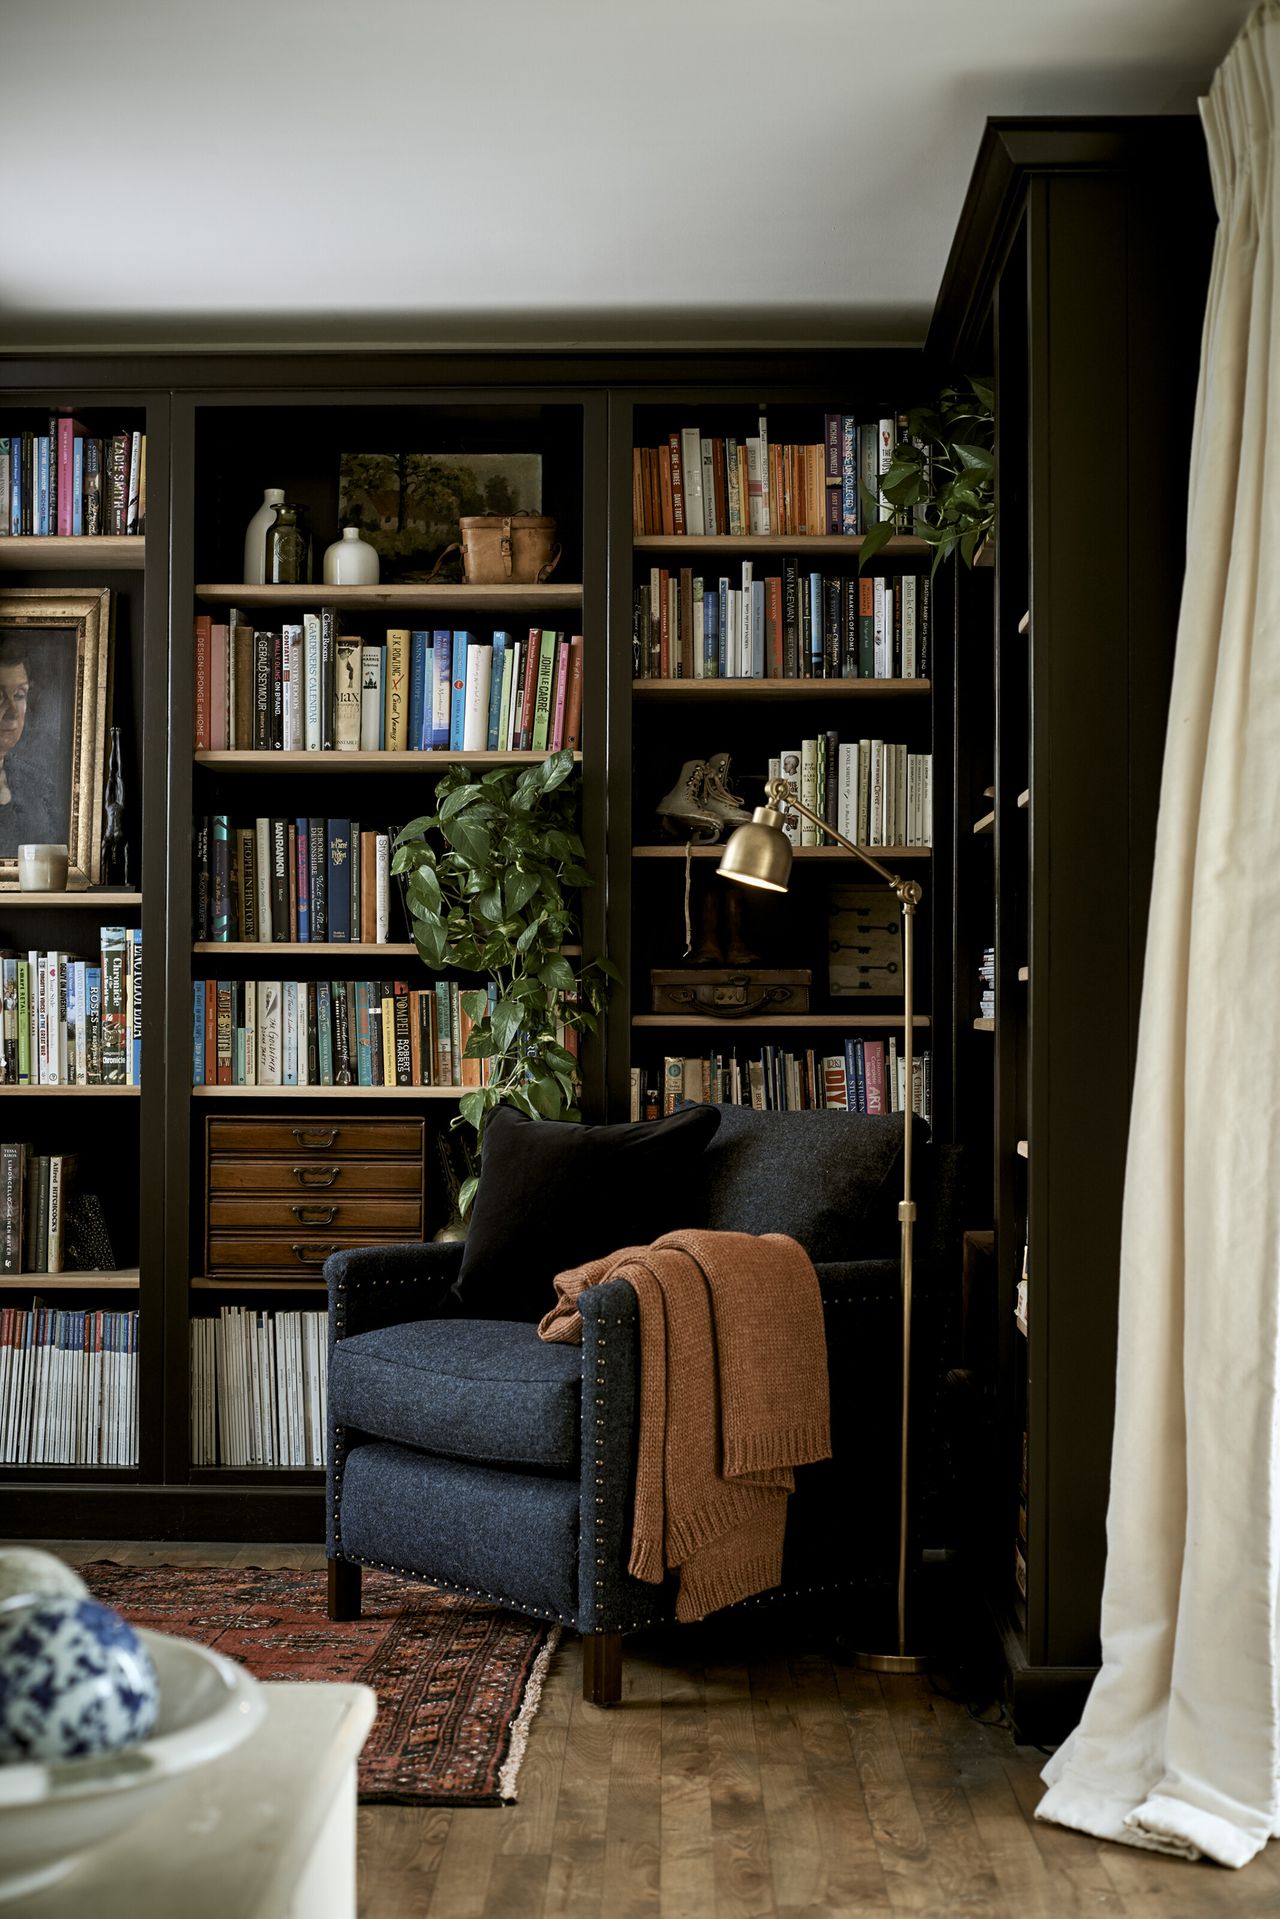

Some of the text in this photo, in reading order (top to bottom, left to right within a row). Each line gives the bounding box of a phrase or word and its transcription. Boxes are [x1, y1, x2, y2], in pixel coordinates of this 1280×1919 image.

[830, 422, 838, 445] MICHAEL
[845, 418, 854, 432] PAUL
[670, 438, 678, 448] ONE
[114, 442, 125, 471] ZADIE
[750, 450, 758, 470] prep
[830, 448, 838, 474] CONNELLY
[672, 470, 680, 485] THREE
[114, 474, 125, 508] SMITH
[674, 494, 682, 507] DAVE
[675, 508, 683, 523] TROTT
[906, 580, 914, 598] John
[323, 614, 332, 636] Classic
[848, 622, 854, 630] OF
[414, 635, 422, 663] JOANNA
[256, 640, 268, 710] GERALD SEYMOUR
[292, 648, 300, 710] COUNTRY FOODS
[537, 654, 551, 713] JOHN LE CARRÉ
[274, 682, 281, 692] ON
[197, 704, 203, 712] at
[309, 677, 317, 724] CALENDAR
[392, 693, 401, 713] Casual
[390, 717, 400, 741] Vacancy
[275, 822, 284, 839] IAN
[276, 840, 284, 877] RANKIN
[378, 839, 387, 861] Style
[199, 872, 207, 894] SIMON
[245, 874, 253, 887] IN
[316, 875, 324, 896] Wait
[246, 890, 254, 936] HISTORY
[314, 898, 324, 910] for
[60, 981, 67, 989] ON
[113, 958, 122, 1006] Chronicle
[284, 984, 295, 997] Night
[320, 984, 328, 997] The
[90, 986, 99, 1023] ROSES
[319, 999, 329, 1020] Crying
[218, 990, 230, 1051] ZADIE SMITH
[396, 996, 408, 1036] POMPEII
[91, 1035, 99, 1066] enjoyment
[269, 1032, 279, 1072] GOLDFINCH
[442, 1063, 450, 1082] Harris
[825, 1070, 846, 1104] DIY
[868, 1087, 881, 1111] ART
